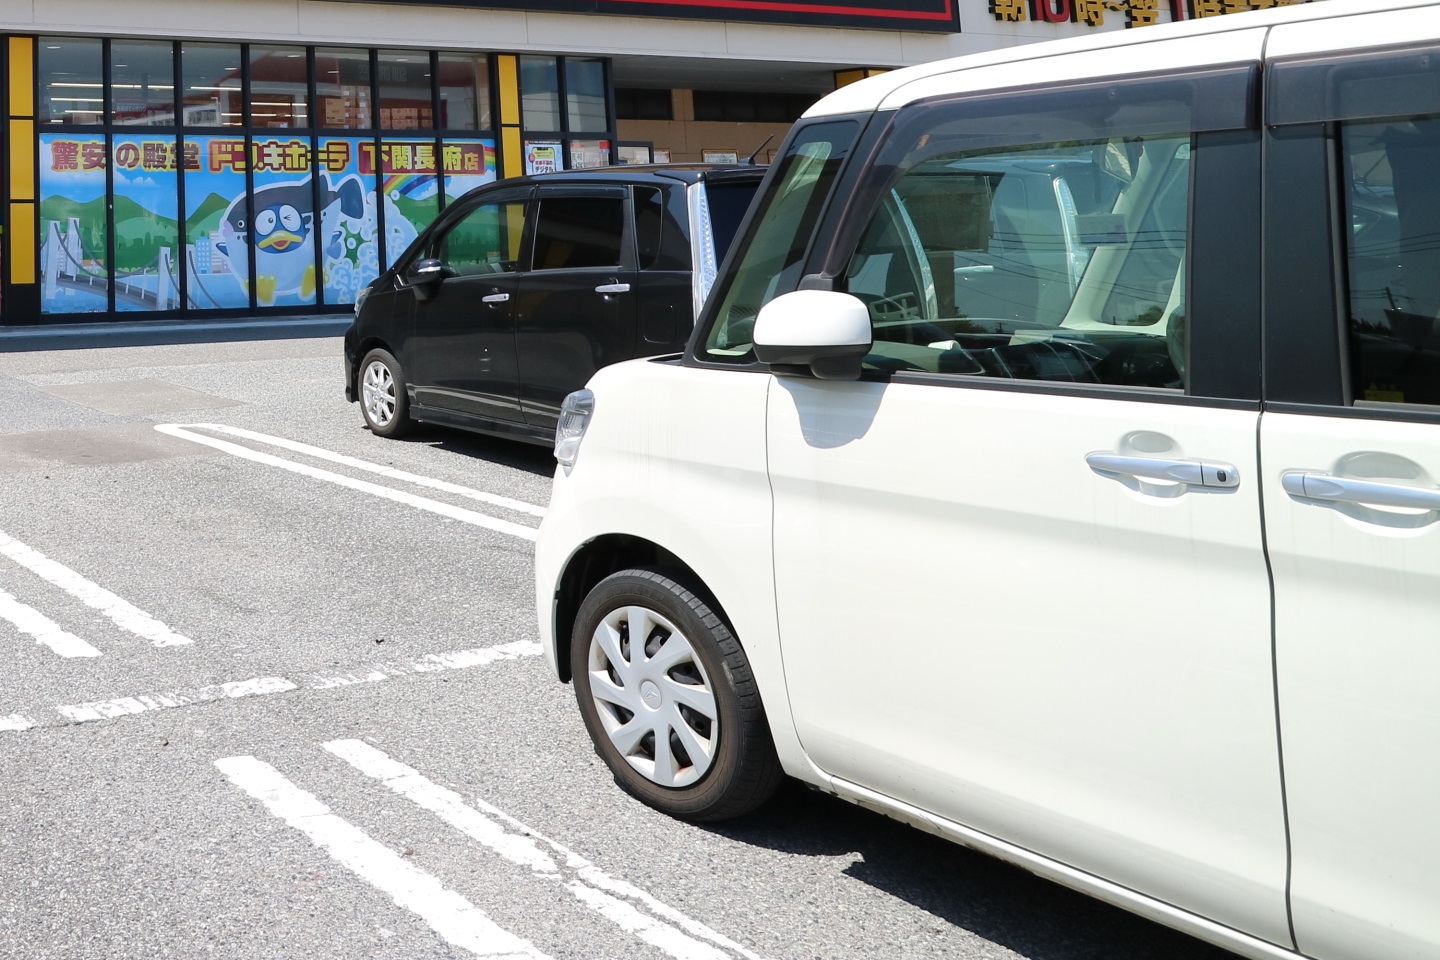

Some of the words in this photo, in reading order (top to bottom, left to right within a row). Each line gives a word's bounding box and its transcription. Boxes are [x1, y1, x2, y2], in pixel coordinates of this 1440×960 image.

[53, 141, 200, 170] 驚安の殿堂
[363, 145, 479, 171] 下関長府店
